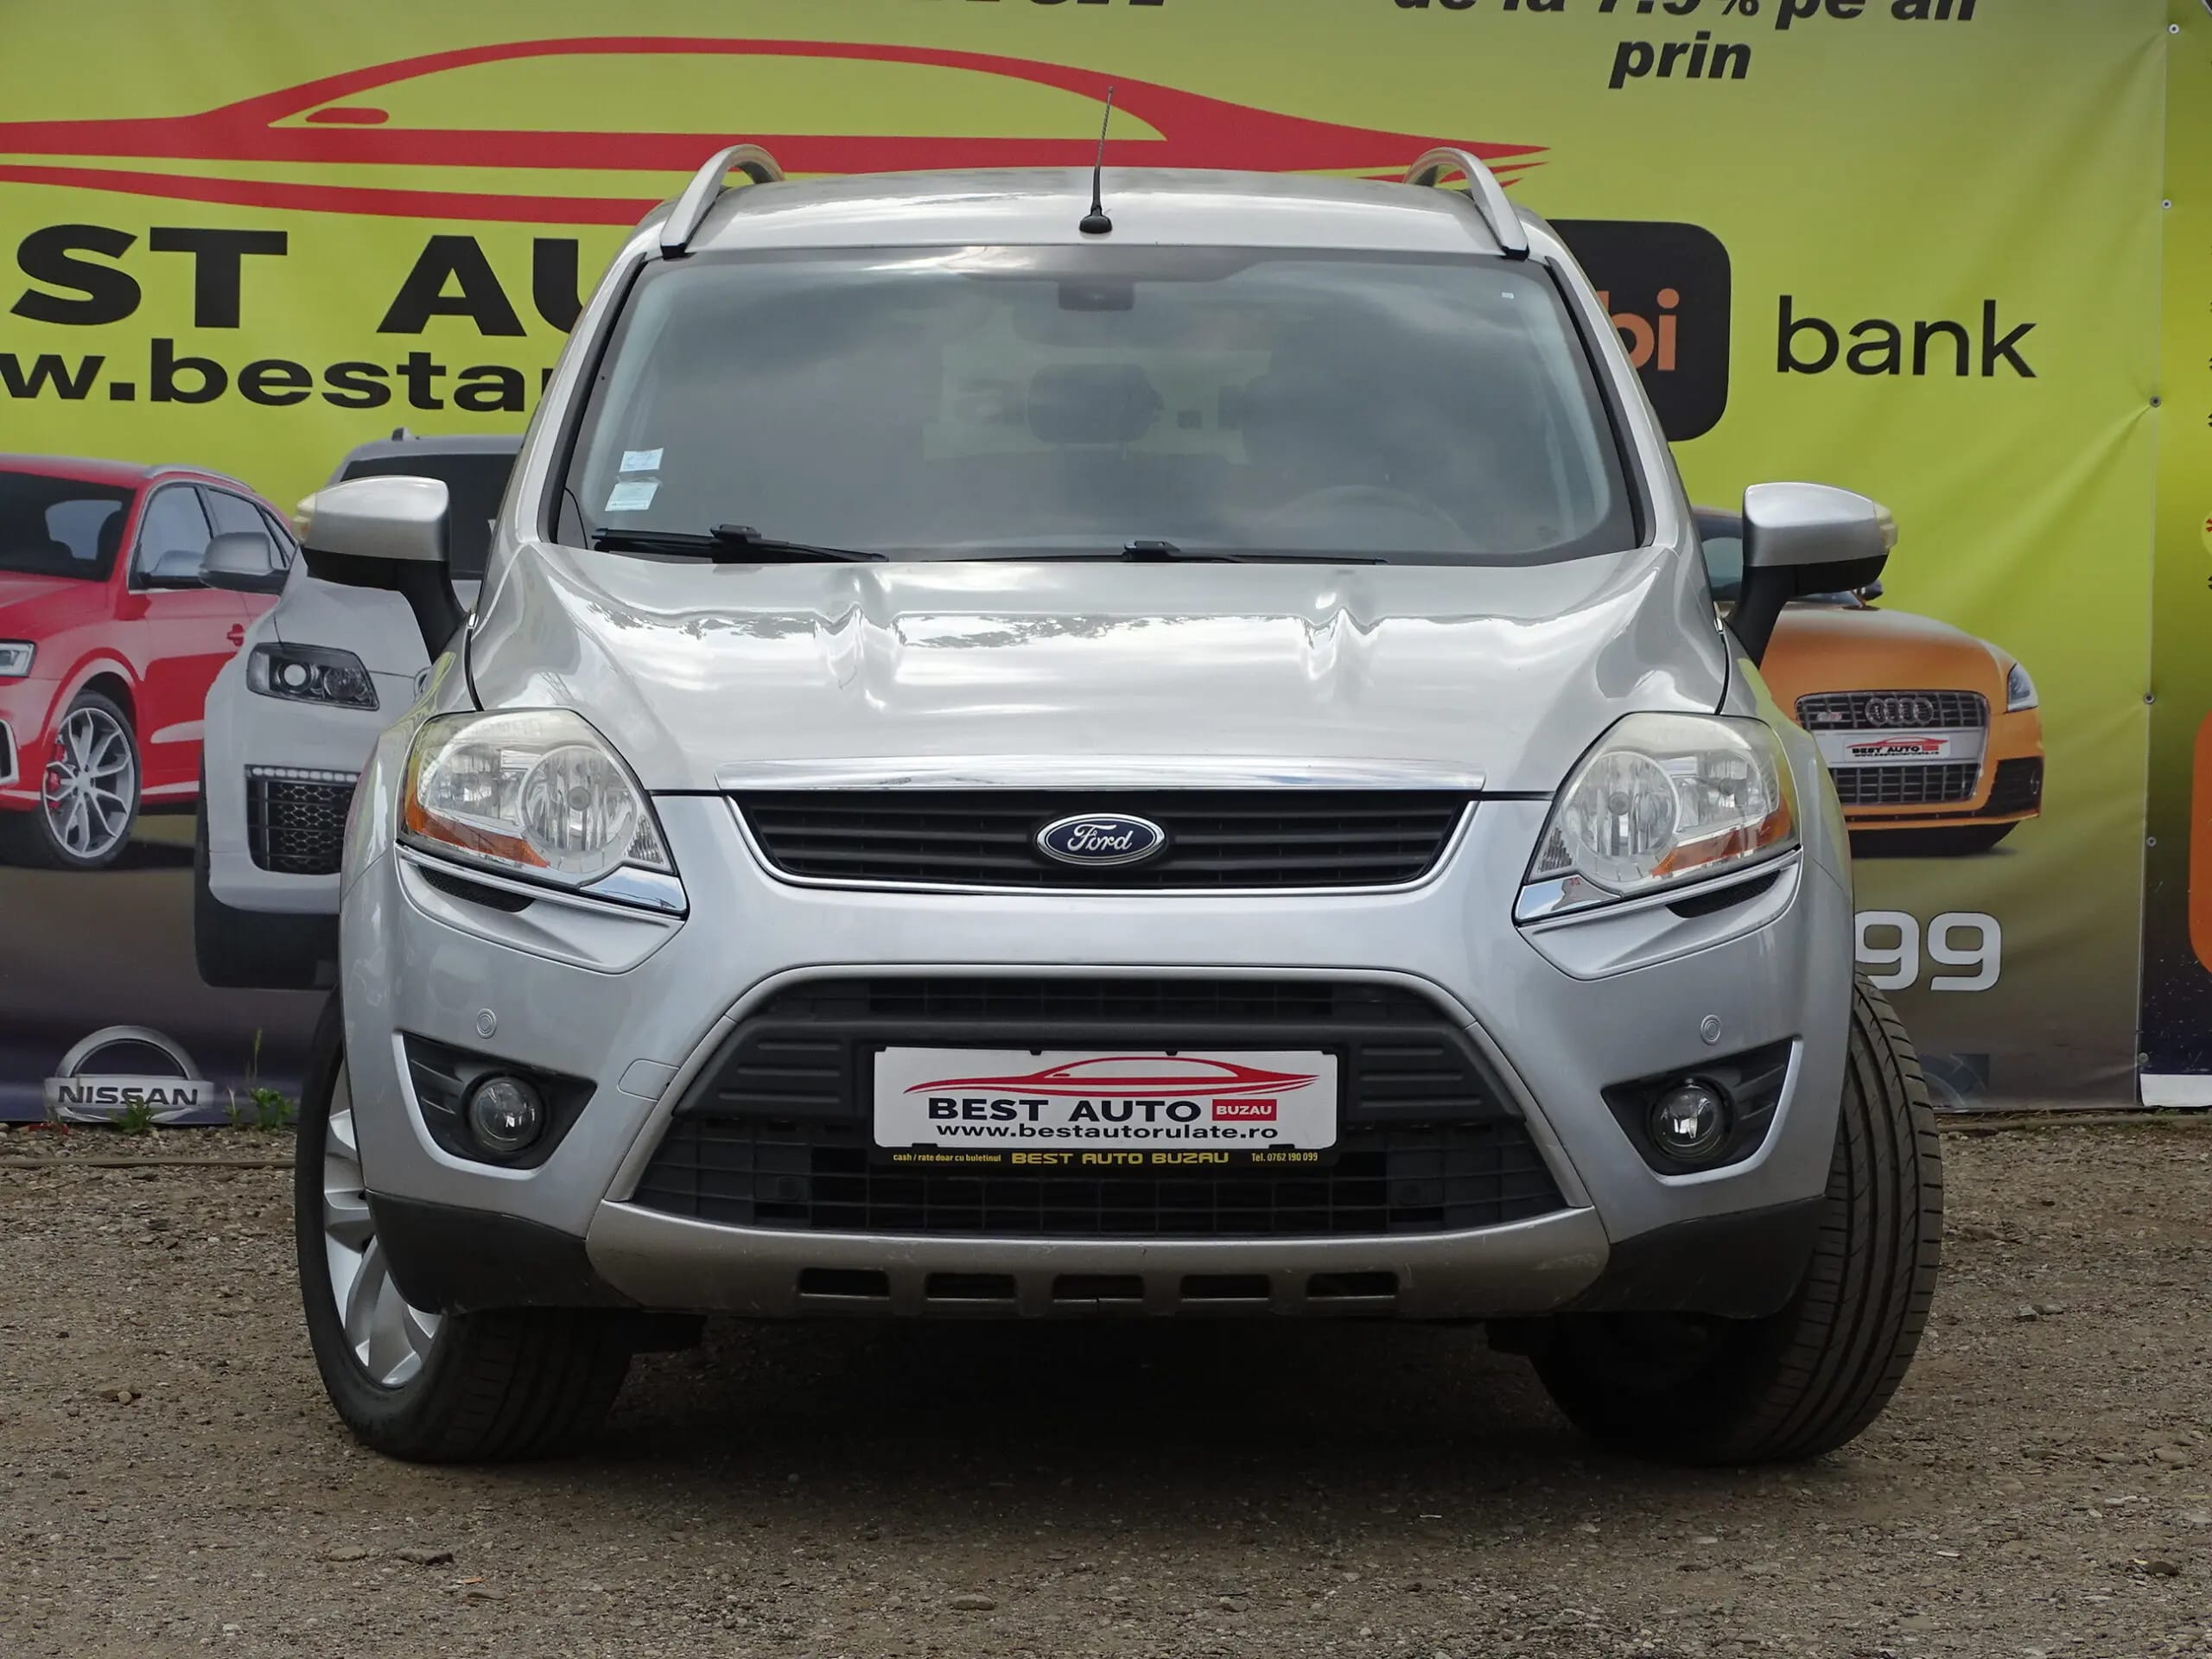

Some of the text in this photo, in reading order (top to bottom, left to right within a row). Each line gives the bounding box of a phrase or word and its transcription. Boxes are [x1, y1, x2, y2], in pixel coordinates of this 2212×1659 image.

[1608, 30, 1752, 90] prin
[10, 224, 288, 329] ST
[1777, 295, 2037, 378] bank
[1067, 823, 1135, 851] Ford
[1855, 910, 2002, 991] 99
[58, 1085, 198, 1106] NISSAN
[928, 1097, 1202, 1122] BEST AUTO
[1216, 1105, 1273, 1116] BUZAU
[936, 1122, 1279, 1139] www.bestautorulate.ro
[935, 1154, 954, 1162] doar
[965, 1154, 1001, 1162] buletinul
[1011, 1152, 1230, 1165] BEST AUTO BUZAU
[1251, 1152, 1319, 1162] Tel. 0762 190 099
